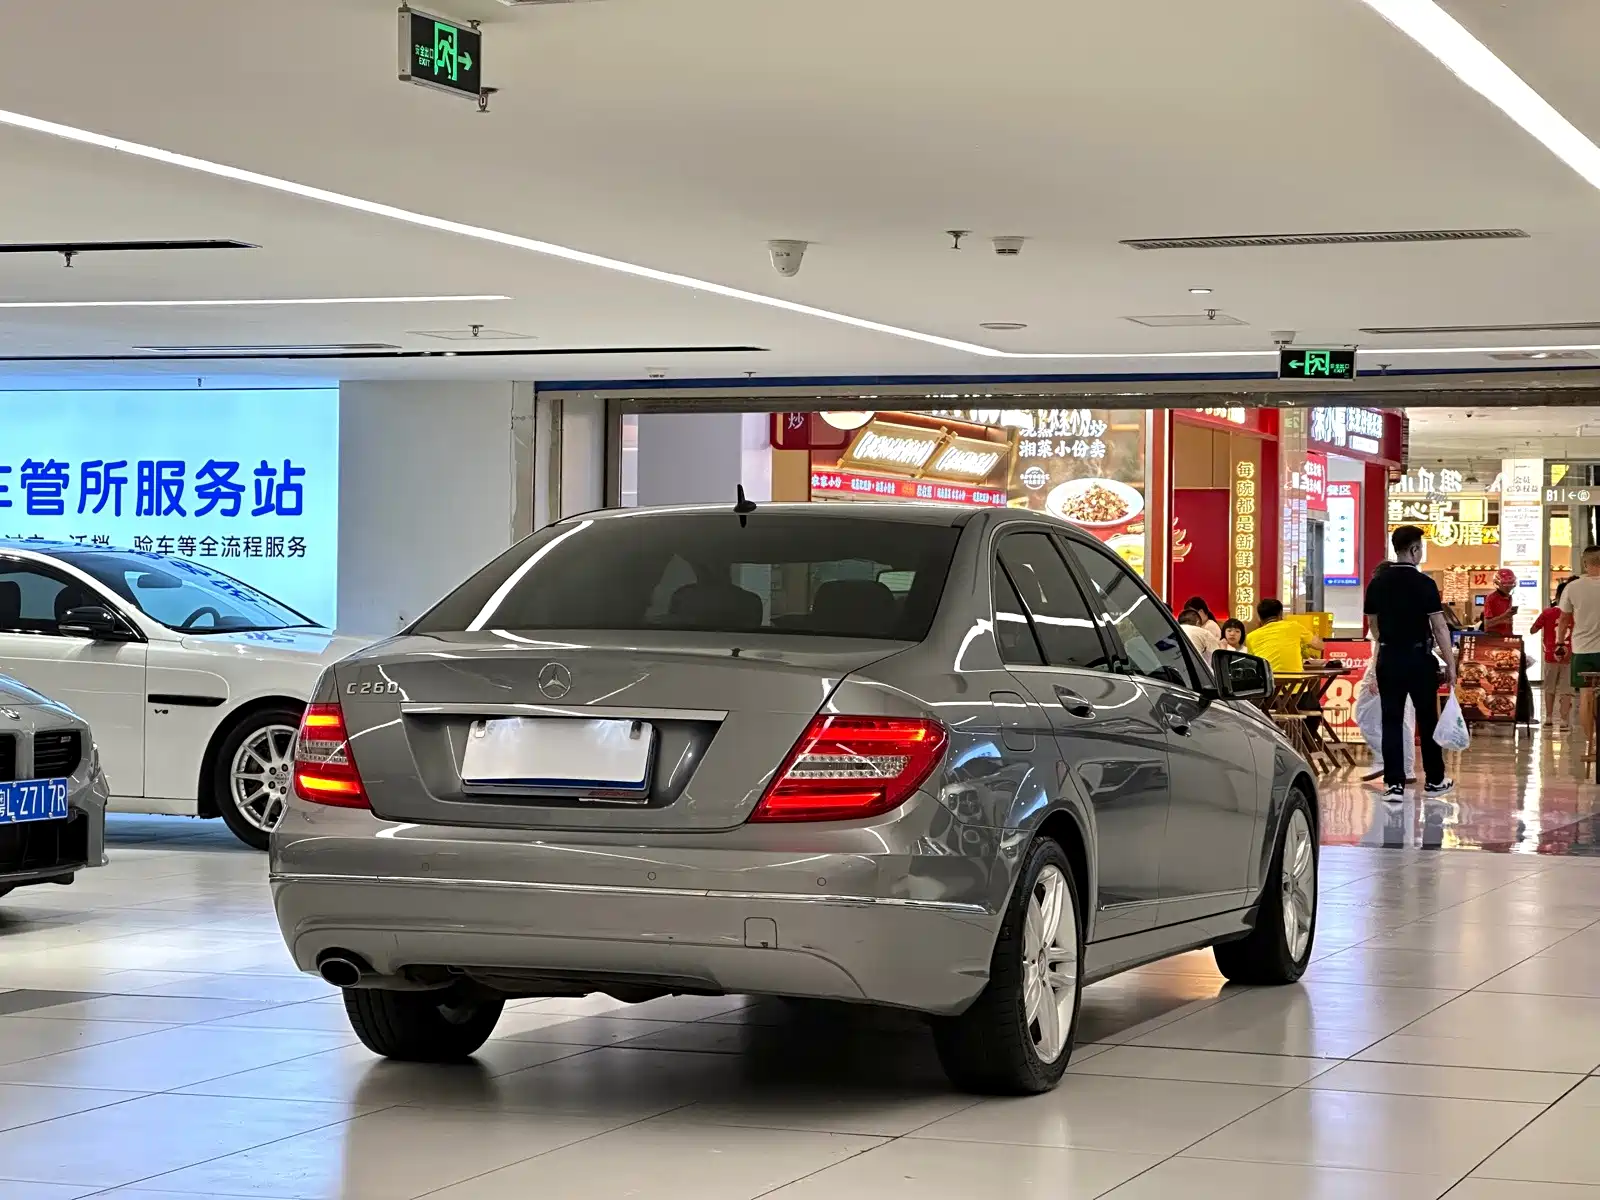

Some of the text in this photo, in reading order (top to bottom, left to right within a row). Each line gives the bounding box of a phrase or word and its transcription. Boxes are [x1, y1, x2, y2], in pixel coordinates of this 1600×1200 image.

[419, 57, 430, 67] EXIT
[1019, 439, 1106, 458] 湘菜小份卖
[0, 458, 306, 517] 管所服务站
[1546, 490, 1558, 501] B1
[1236, 462, 1254, 622] 每碗都是新鲜肉烧制
